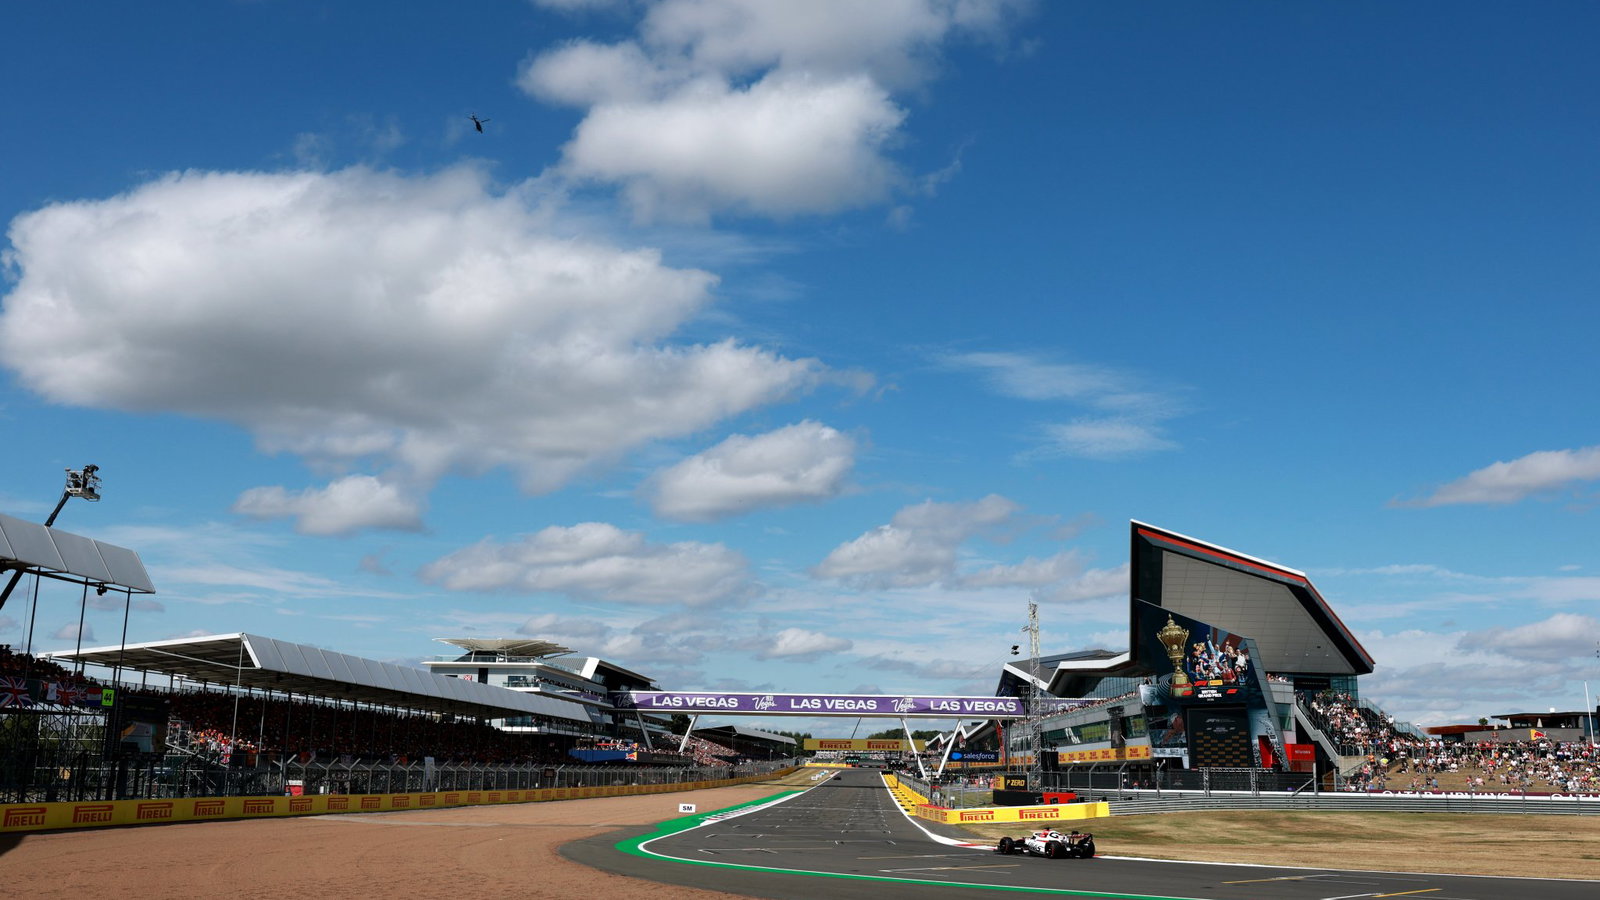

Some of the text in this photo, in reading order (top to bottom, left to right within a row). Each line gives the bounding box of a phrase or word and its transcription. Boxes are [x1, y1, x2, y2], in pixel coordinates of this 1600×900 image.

[652, 696, 739, 708] LAS VEGAS
[790, 698, 877, 710] LAS VEGAS
[930, 700, 1017, 712] LAS VEGAS
[963, 752, 996, 760] salesforce
[192, 800, 225, 816] PIRELLI
[242, 799, 274, 814] PIRELLI
[289, 798, 313, 812] PIRELLI
[328, 797, 349, 810] PIRELLI
[360, 796, 381, 809] PIRELLI
[3, 807, 47, 827] PIRELLI
[72, 804, 114, 823] PIRELLI
[136, 802, 174, 819] PIRELLI
[959, 810, 995, 821] PIRELLI
[1018, 808, 1060, 819] PIRELLI
